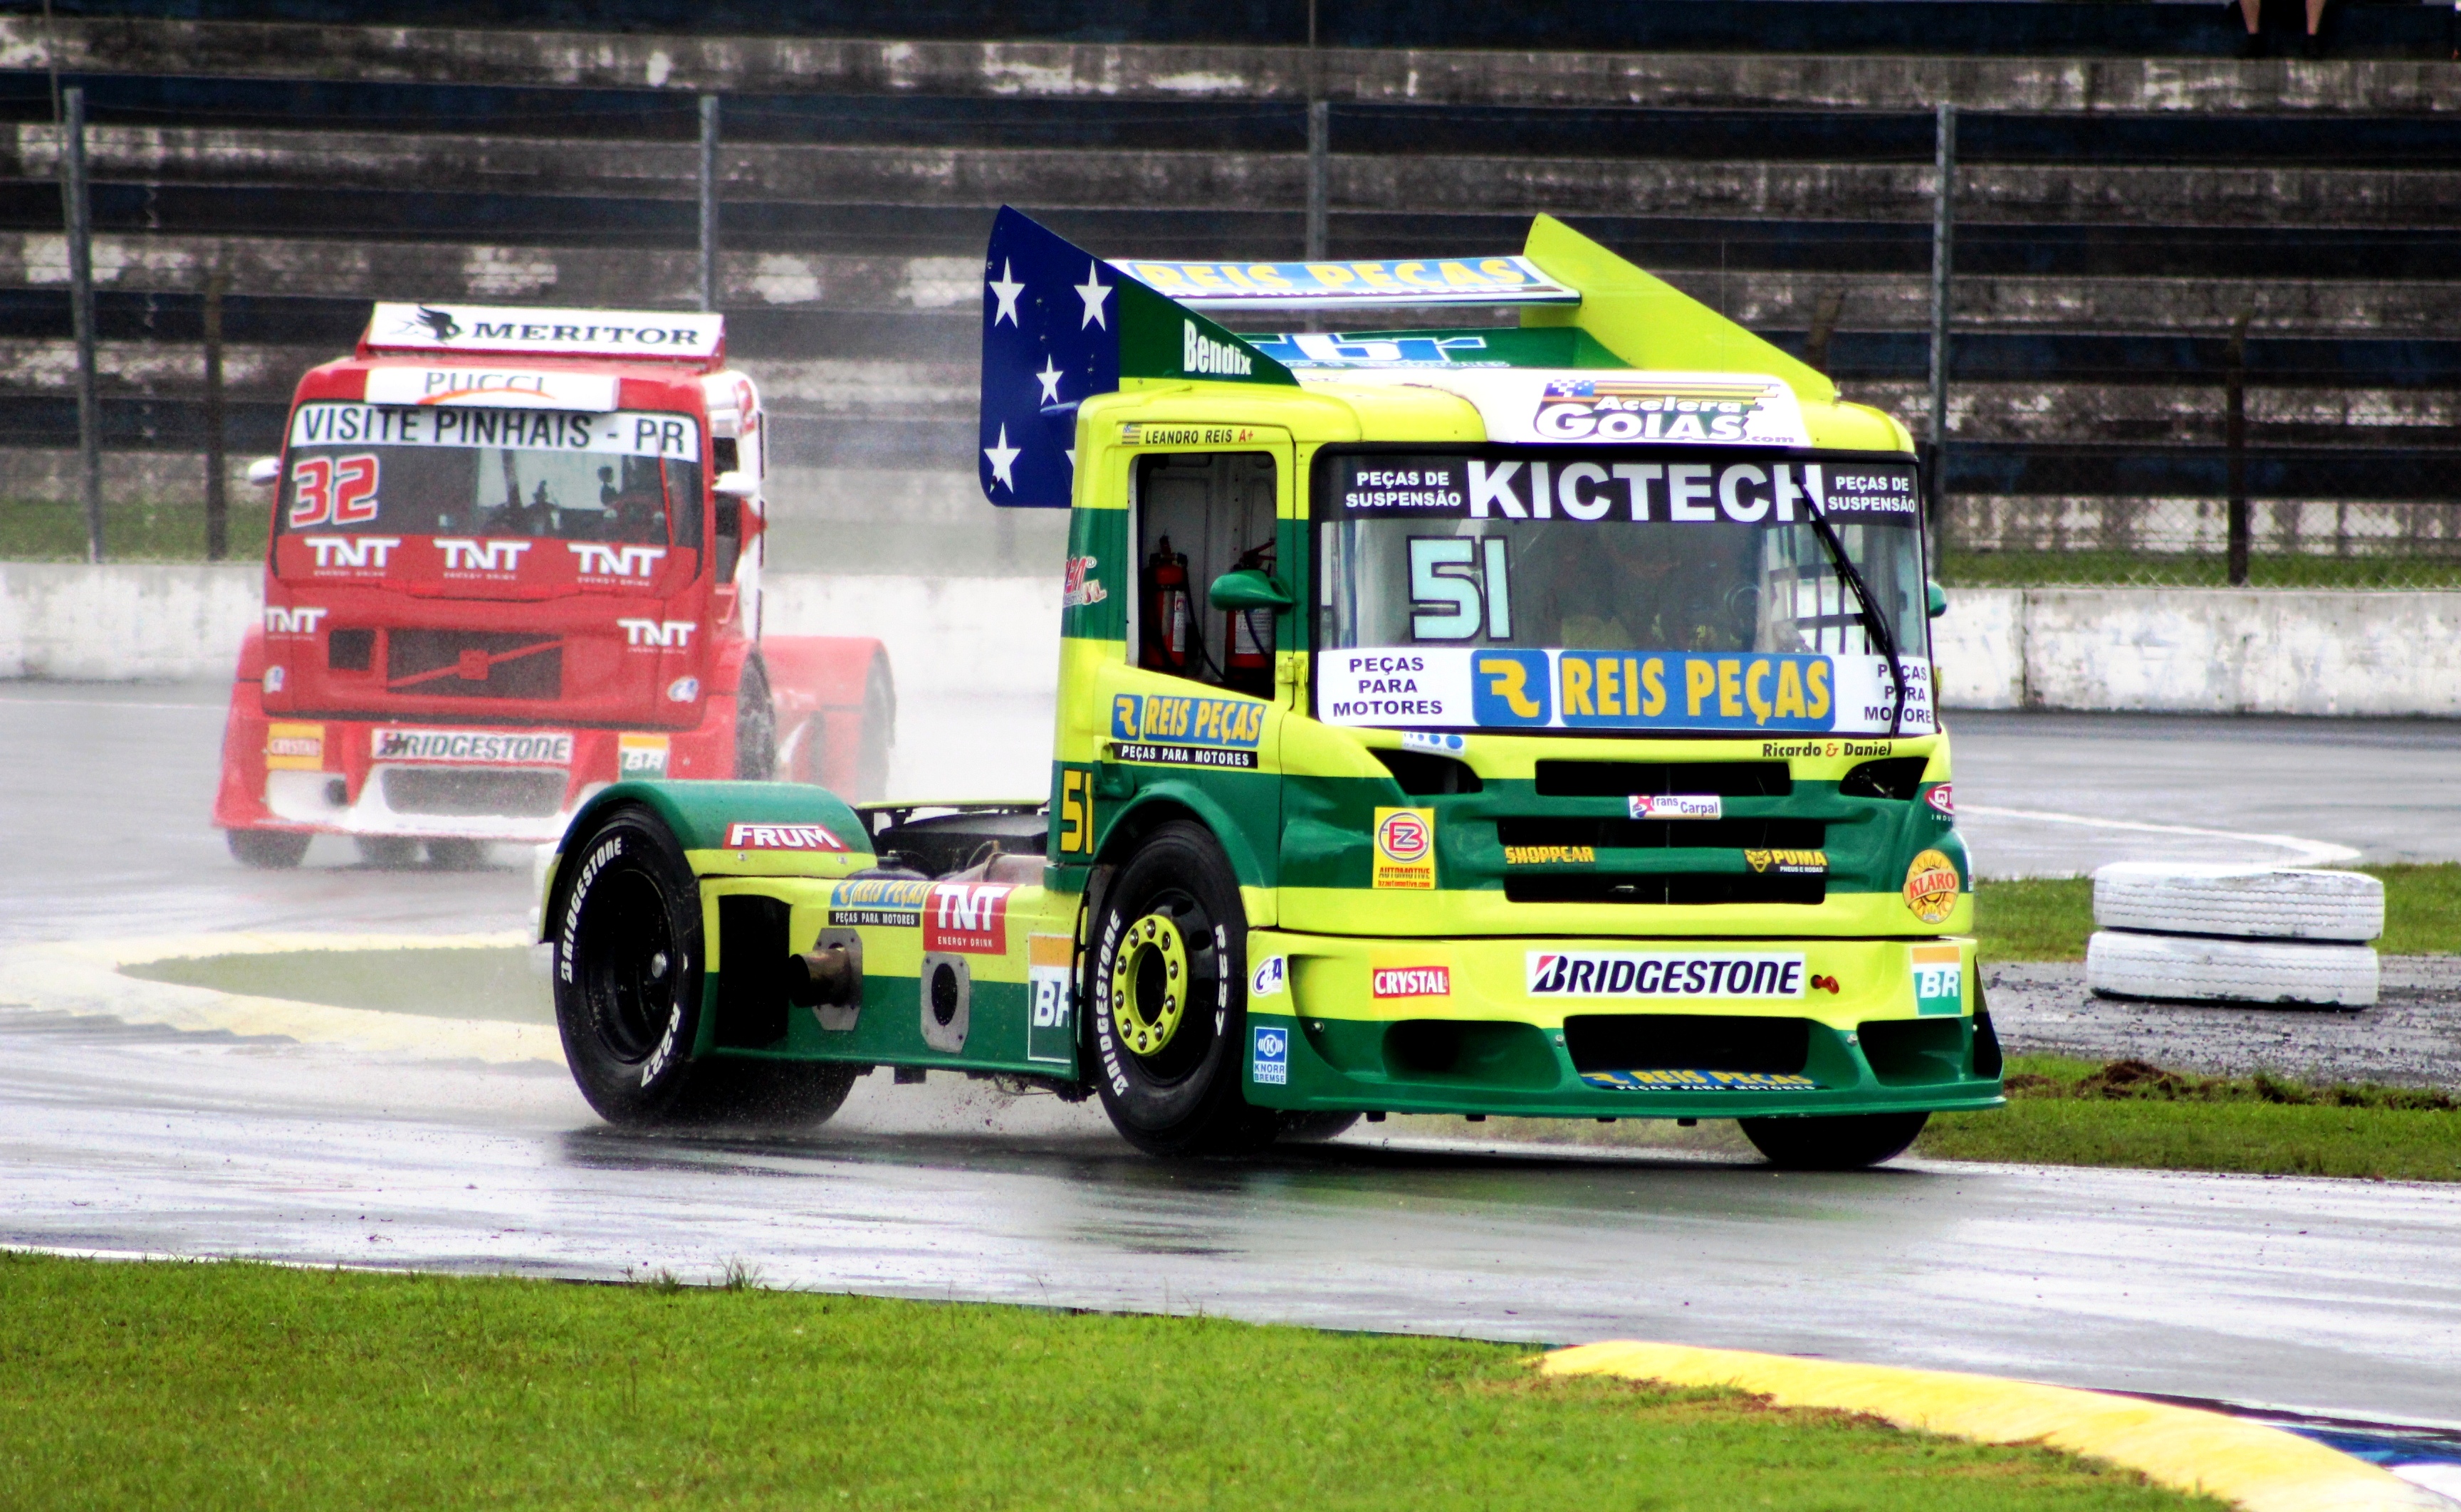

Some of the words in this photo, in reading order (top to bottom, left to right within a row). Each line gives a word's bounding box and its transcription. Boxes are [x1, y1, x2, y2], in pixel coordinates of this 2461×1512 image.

[472, 322, 699, 345] MERITOR
[1183, 317, 1252, 376] Bendix
[1594, 396, 1743, 413] Acelera
[304, 407, 419, 442] VISITE
[434, 409, 593, 448] PINHAIS
[634, 416, 684, 454] PR
[1144, 429, 1199, 445] LEANDRO
[1205, 429, 1233, 443] REIS
[1238, 428, 1254, 443] A+
[289, 453, 380, 528] 32
[1356, 471, 1420, 489] PEÇAS
[1425, 471, 1450, 486] DE
[1467, 460, 1825, 522] KICTECH
[1835, 476, 1888, 494] PEÇAS
[1891, 477, 1910, 492] DE
[1345, 489, 1462, 508] SUSPENSÃO
[1827, 495, 1916, 513] SUSPENSÃO
[303, 537, 402, 568] TNT
[432, 538, 533, 570] TNT
[567, 542, 667, 577] TNT
[1406, 535, 1513, 641] 51
[264, 607, 328, 634] TNT
[616, 617, 697, 647] TNT
[1349, 657, 1425, 676] PEÇAS
[1877, 663, 1928, 683] PÇAS
[1357, 678, 1418, 694] PARA
[1561, 656, 1666, 718] REIS
[1685, 659, 1832, 726] PEÇAS
[1884, 685, 1926, 703] PRA
[1145, 698, 1192, 736] REIS
[1193, 700, 1264, 745] PEÇAS
[1332, 700, 1443, 718] MOTORES
[378, 733, 570, 761] BRIDGESTONE
[1121, 745, 1156, 762] PEÇAS
[1162, 748, 1188, 762] PARA
[1195, 750, 1250, 767] MOTORES
[1762, 742, 1822, 757] Ricardo
[1825, 742, 1839, 757] &
[1843, 741, 1892, 756] Daniel
[624, 750, 666, 771] BR
[1060, 769, 1094, 854] 51
[1681, 801, 1718, 817] Carpal
[730, 824, 842, 849] FRUM
[1771, 849, 1828, 866] PUMA
[1379, 866, 1430, 879] AUTOMOTIVE
[1908, 872, 1957, 900] KLARO
[560, 836, 623, 983] BRIDGESTONE
[835, 912, 858, 925] PEÇAS
[861, 912, 879, 924] PARA
[882, 913, 915, 925] MOTORES
[934, 883, 1011, 932] TNT
[938, 935, 966, 946] ENERGY
[971, 938, 993, 947] DRINK
[1214, 924, 1230, 1037] R227
[1374, 970, 1447, 995] CRYSTAL
[1532, 954, 1802, 995] BRIDGESTONE
[1920, 971, 1959, 998] BR
[1095, 908, 1129, 1097] BRIDGESTONE
[642, 1002, 681, 1088] R227
[1254, 1063, 1285, 1074] KNORR
[1254, 1073, 1285, 1083] BREMSE
[1631, 1069, 1708, 1083] REIS
[1708, 1071, 1814, 1086] PEÇAS
